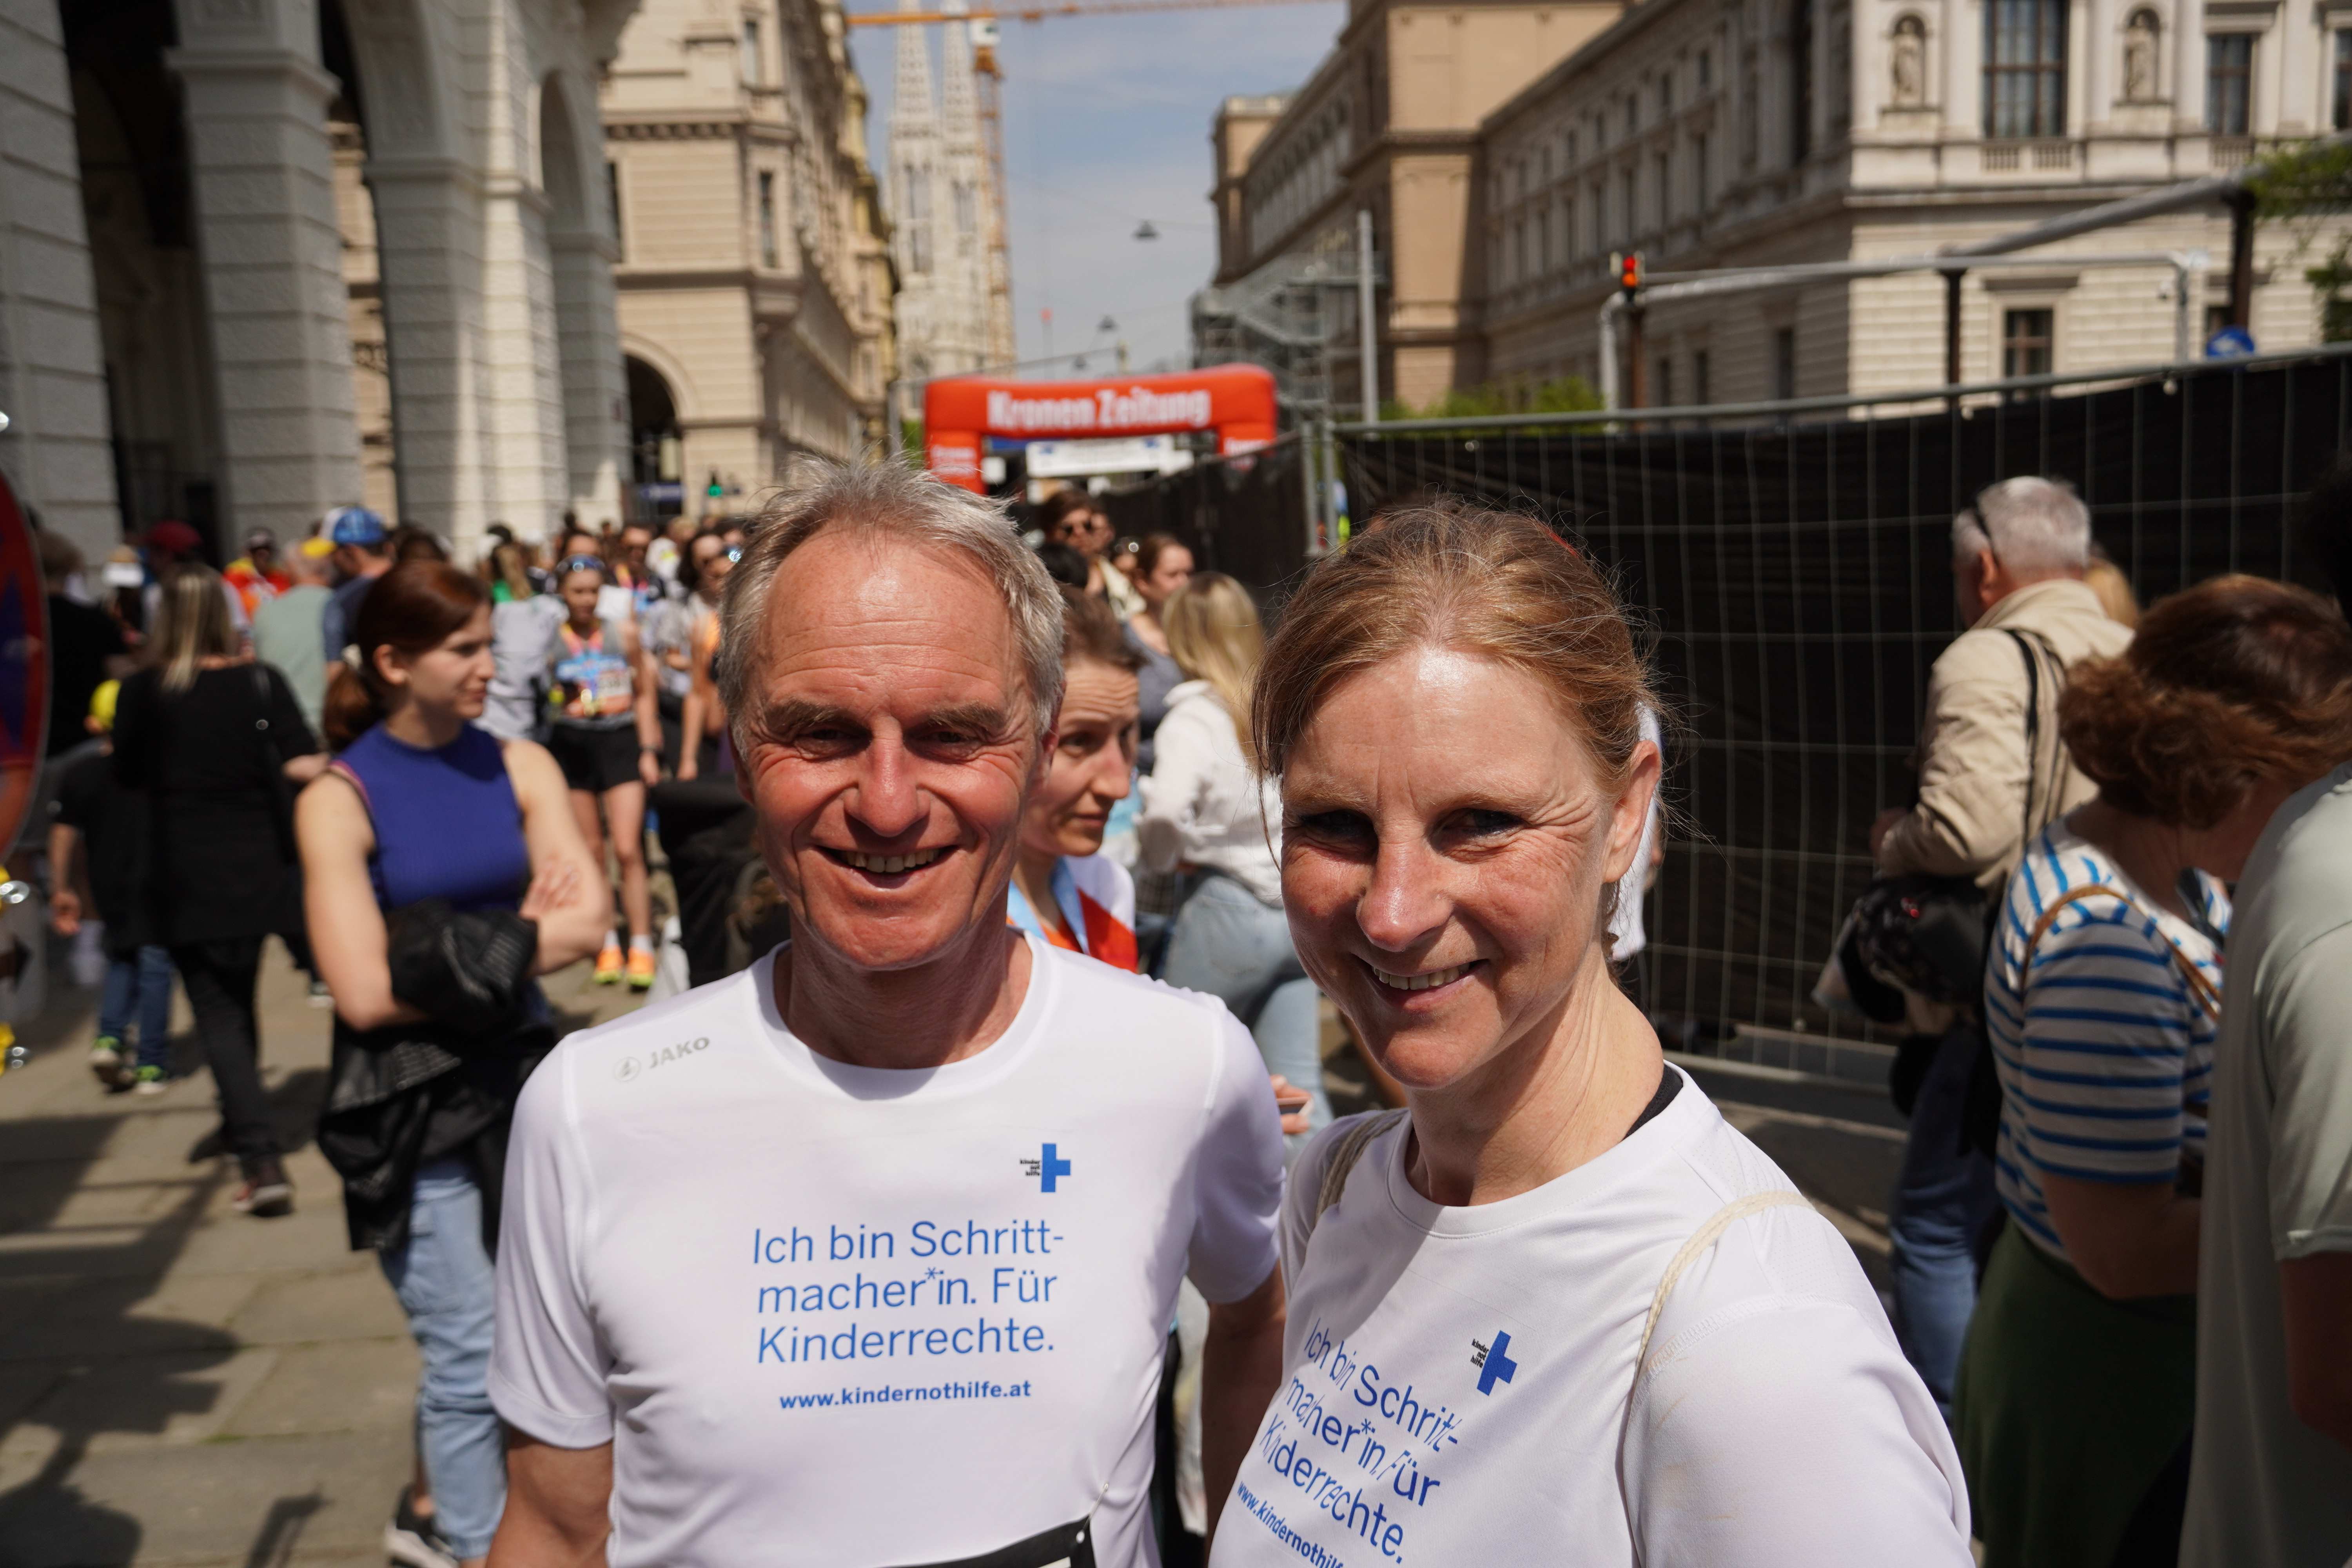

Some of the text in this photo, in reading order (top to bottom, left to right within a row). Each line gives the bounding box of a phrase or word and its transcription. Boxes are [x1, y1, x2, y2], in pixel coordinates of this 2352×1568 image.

[987, 387, 1211, 430] Kronen Zeitung
[649, 1036, 711, 1069] JAKO
[753, 1219, 1064, 1264] Ich bin Schritt-
[993, 1267, 1058, 1304] Für
[758, 1318, 1054, 1364] Kinderrechte.
[1304, 1318, 1331, 1370] Ich
[1329, 1340, 1357, 1391] bin
[1472, 1338, 1489, 1354] kinder
[1477, 1351, 1486, 1361] not
[1470, 1355, 1484, 1368] hilfe
[779, 1380, 1032, 1410] www.kindernothilfe.at
[1259, 1413, 1403, 1565] Kinderrechte.
